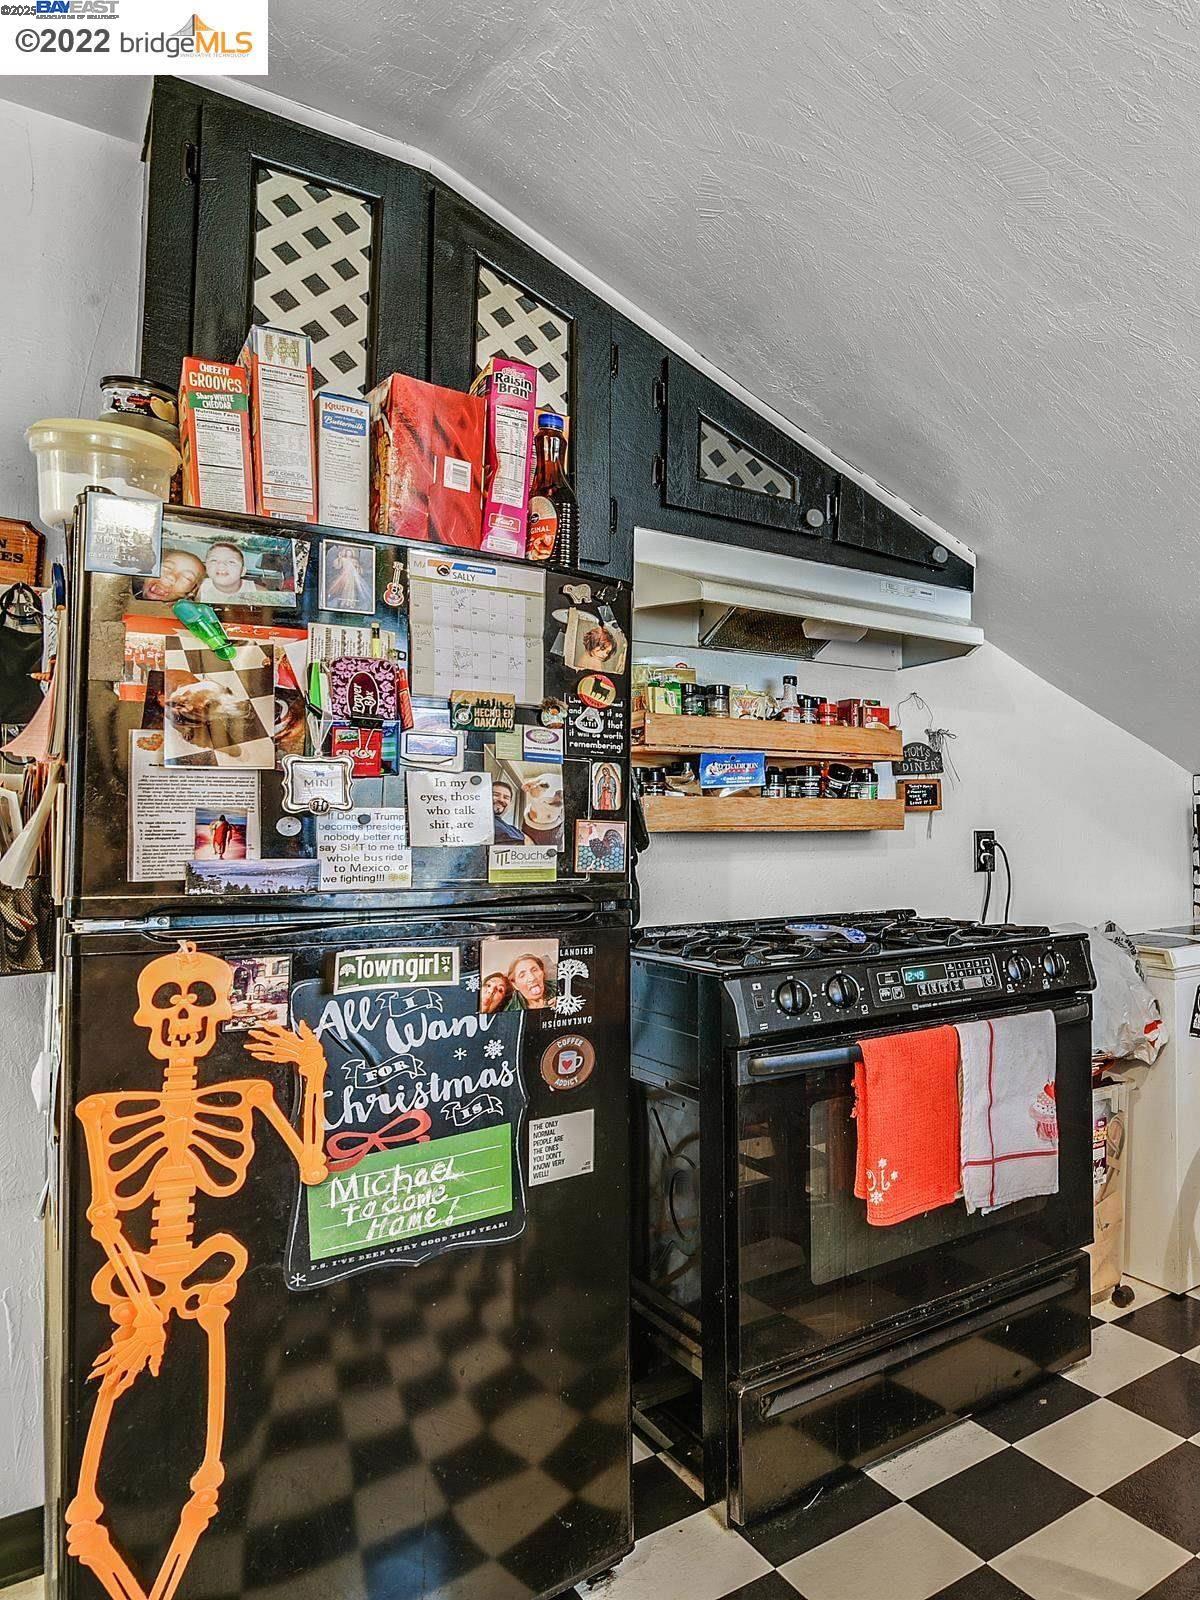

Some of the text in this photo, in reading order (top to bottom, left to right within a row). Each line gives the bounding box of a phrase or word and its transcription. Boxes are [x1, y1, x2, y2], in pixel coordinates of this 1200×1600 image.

[494, 372, 532, 393] Raisin
[498, 383, 528, 399] Bran
[452, 572, 475, 582] SALLY
[474, 718, 514, 729] OAKLAND
[608, 720, 623, 729] that
[570, 740, 623, 753] remembering!
[904, 745, 931, 758] MOM'S
[903, 760, 938, 772] DINER
[304, 779, 333, 787] MINI
[435, 778, 467, 790] In my
[420, 792, 480, 804] eyes, those
[426, 806, 476, 815] who talk
[374, 812, 404, 821] Trump
[319, 823, 363, 831] becomes
[430, 820, 474, 830] shit, are
[324, 833, 360, 842] nobody
[363, 833, 391, 841] better
[440, 834, 464, 843] shit.
[319, 845, 337, 853] say
[368, 843, 377, 851] to
[327, 853, 360, 862] whole
[364, 853, 383, 861] bus
[511, 851, 553, 861] Bouche
[334, 865, 346, 873] to
[340, 874, 385, 884] fighting!!!
[559, 948, 594, 957] LANDISH
[355, 953, 451, 982] Towngirl ST
[905, 972, 925, 982] 12:49
[313, 997, 382, 1041] All
[556, 1038, 584, 1048] COFFEE
[363, 1060, 410, 1083] FOR
[554, 1076, 579, 1087] ADDICT
[461, 1103, 483, 1120] IS
[533, 1121, 558, 1131] THE ONLY
[533, 1129, 555, 1139] NORMAL
[533, 1137, 552, 1147] PEOPLE
[545, 1144, 559, 1152] ONES
[533, 1159, 565, 1171] KNOW VERY
[358, 1250, 387, 1261] BEEN
[389, 1243, 418, 1254] VERY
[420, 1235, 449, 1247] GOOD
[450, 1228, 477, 1240] THIS
[479, 1220, 509, 1233] YEAR!
